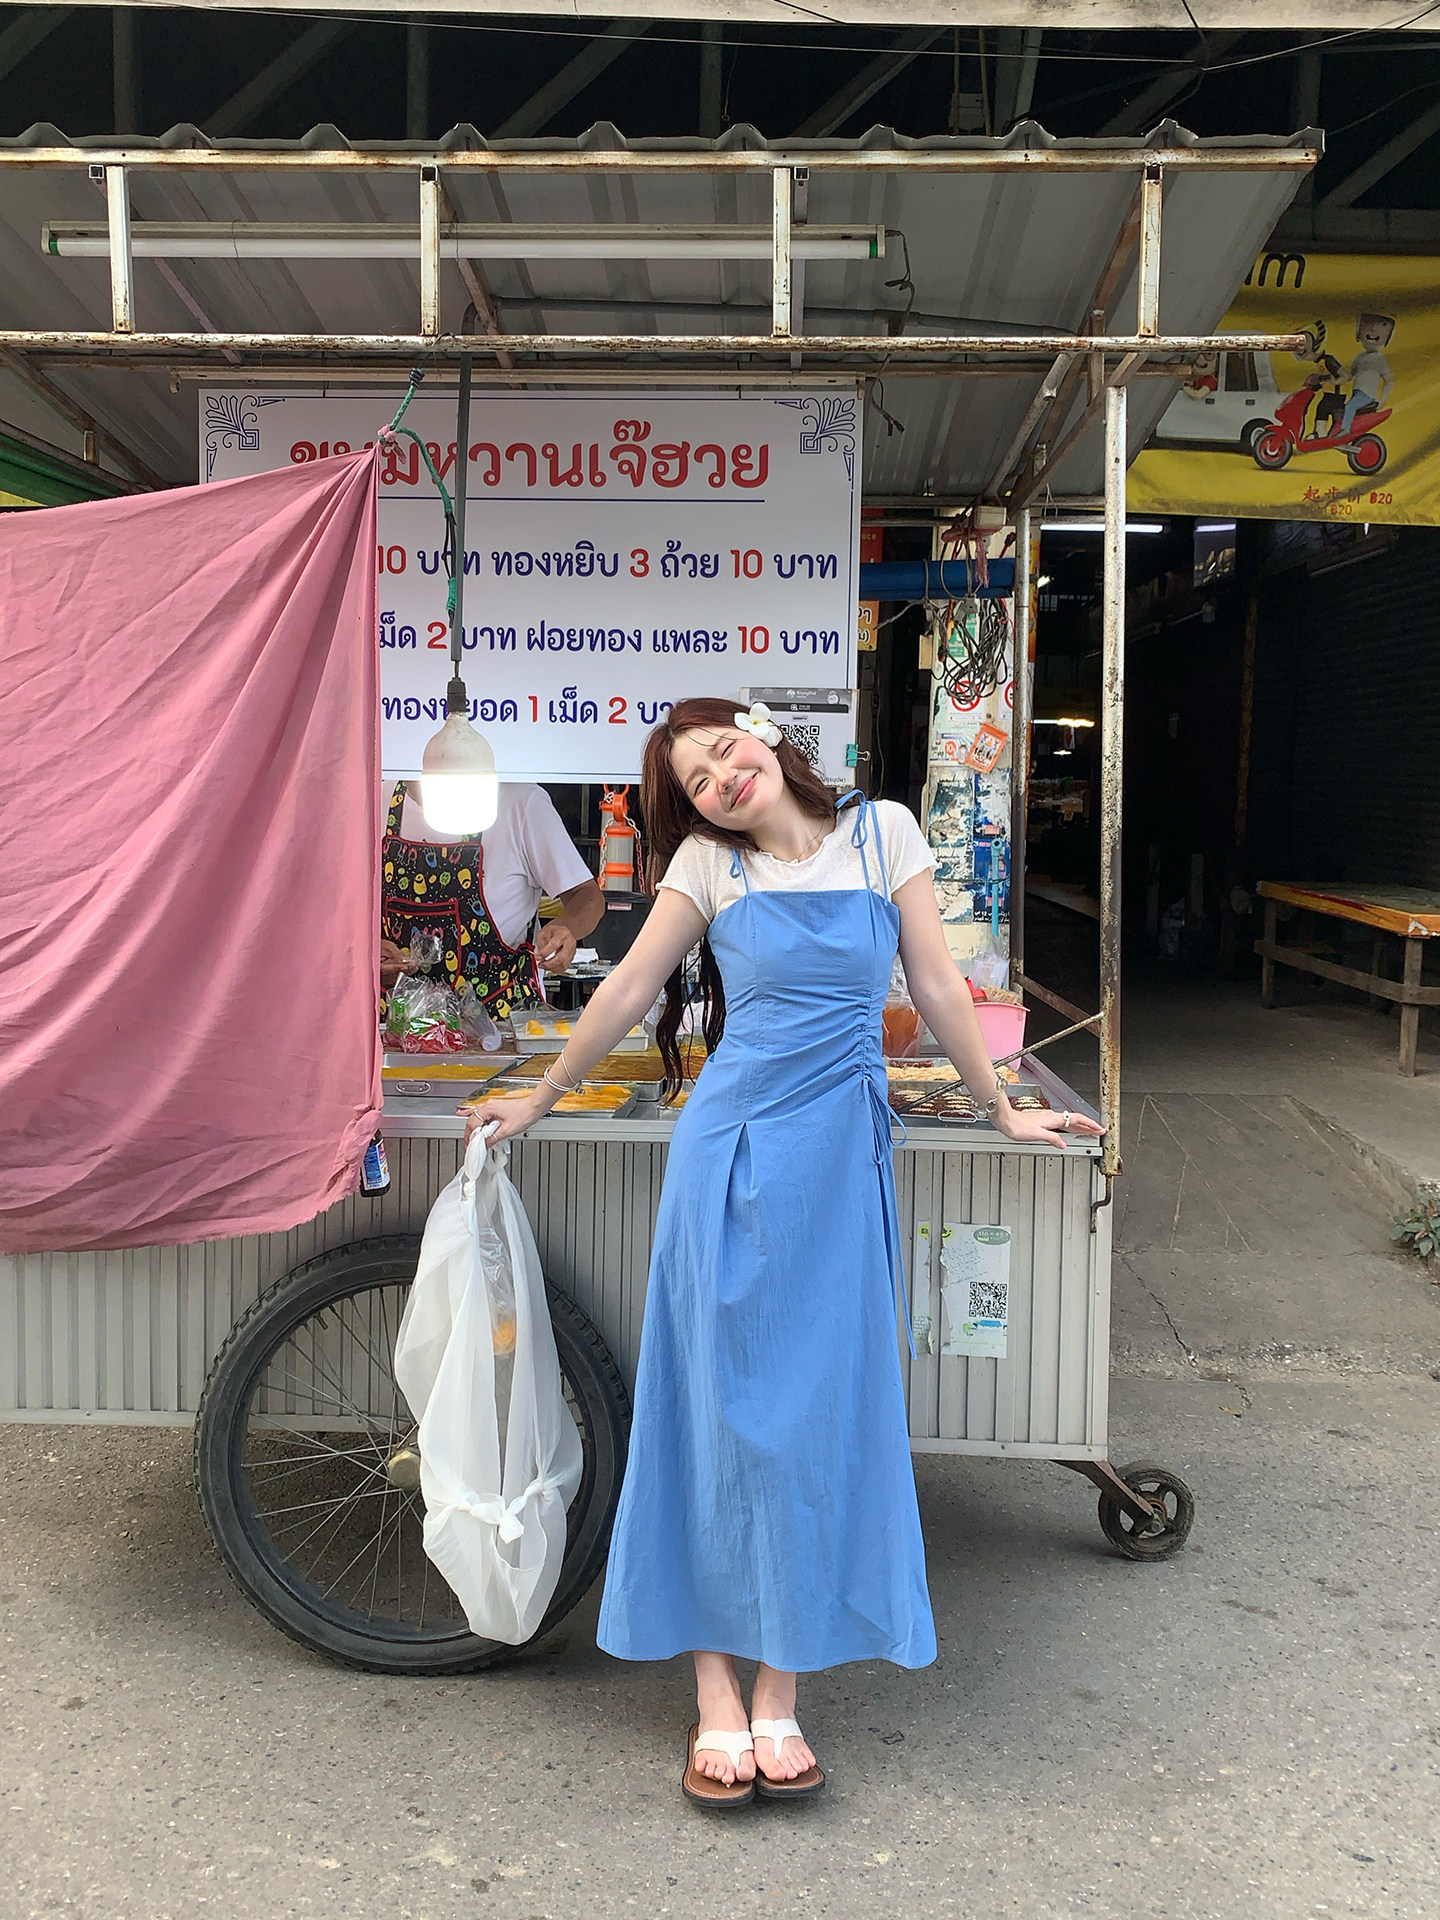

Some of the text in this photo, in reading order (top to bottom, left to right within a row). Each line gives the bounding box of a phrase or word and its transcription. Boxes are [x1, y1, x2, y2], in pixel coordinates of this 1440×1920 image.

[1245, 253, 1306, 289] m
[491, 540, 619, 577] ทองหยิบ
[629, 548, 650, 578] 3
[660, 540, 720, 579] ถ้วย
[730, 549, 763, 579] 10
[773, 553, 838, 579] บาท
[427, 621, 448, 650] 2
[461, 627, 517, 651] บาท
[527, 620, 642, 652] ฝอยทอง
[652, 629, 728, 653] แพละ
[737, 626, 770, 654] 10
[779, 630, 840, 655] บาท
[528, 695, 538, 723] 1
[549, 685, 598, 724] เม็ด
[608, 696, 628, 724] 2
